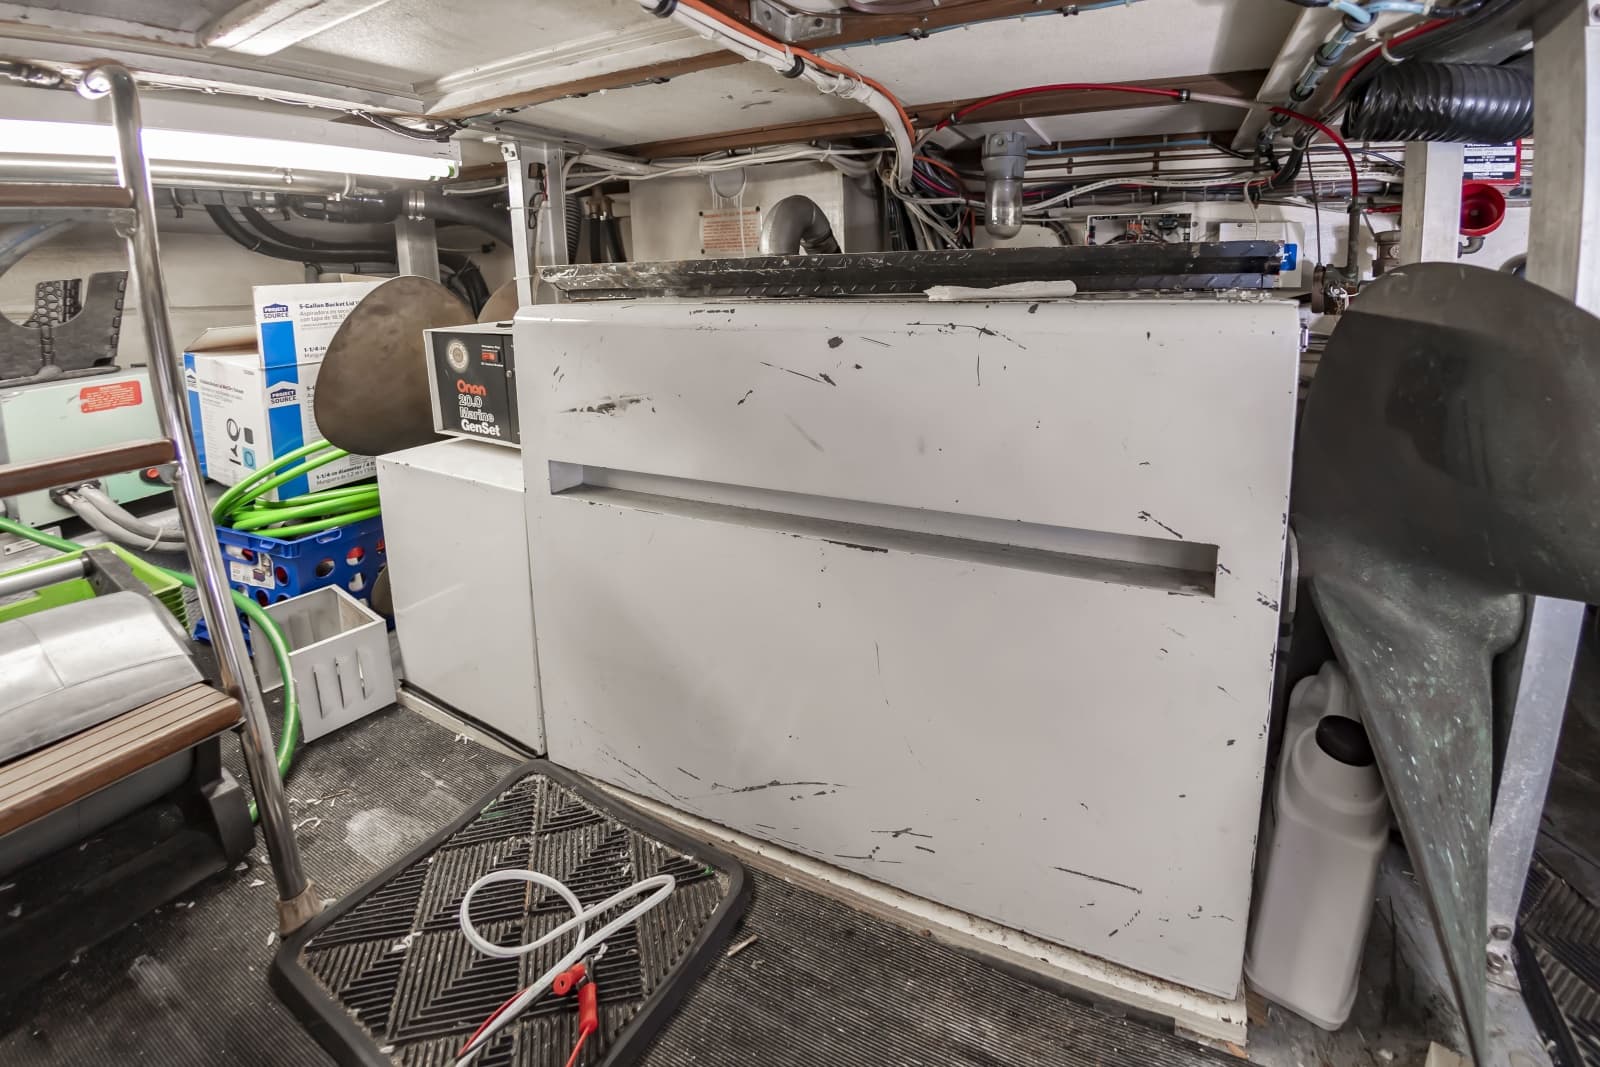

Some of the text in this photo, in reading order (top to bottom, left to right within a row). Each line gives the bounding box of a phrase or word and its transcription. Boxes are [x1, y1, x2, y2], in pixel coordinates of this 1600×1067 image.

[271, 390, 295, 399] PROJECT
[457, 379, 486, 396] Onan
[271, 395, 296, 404] SOURCE
[458, 393, 482, 408] 20.0
[459, 406, 494, 422] Marine
[461, 419, 501, 436] GenSet
[339, 464, 362, 474] diameter
